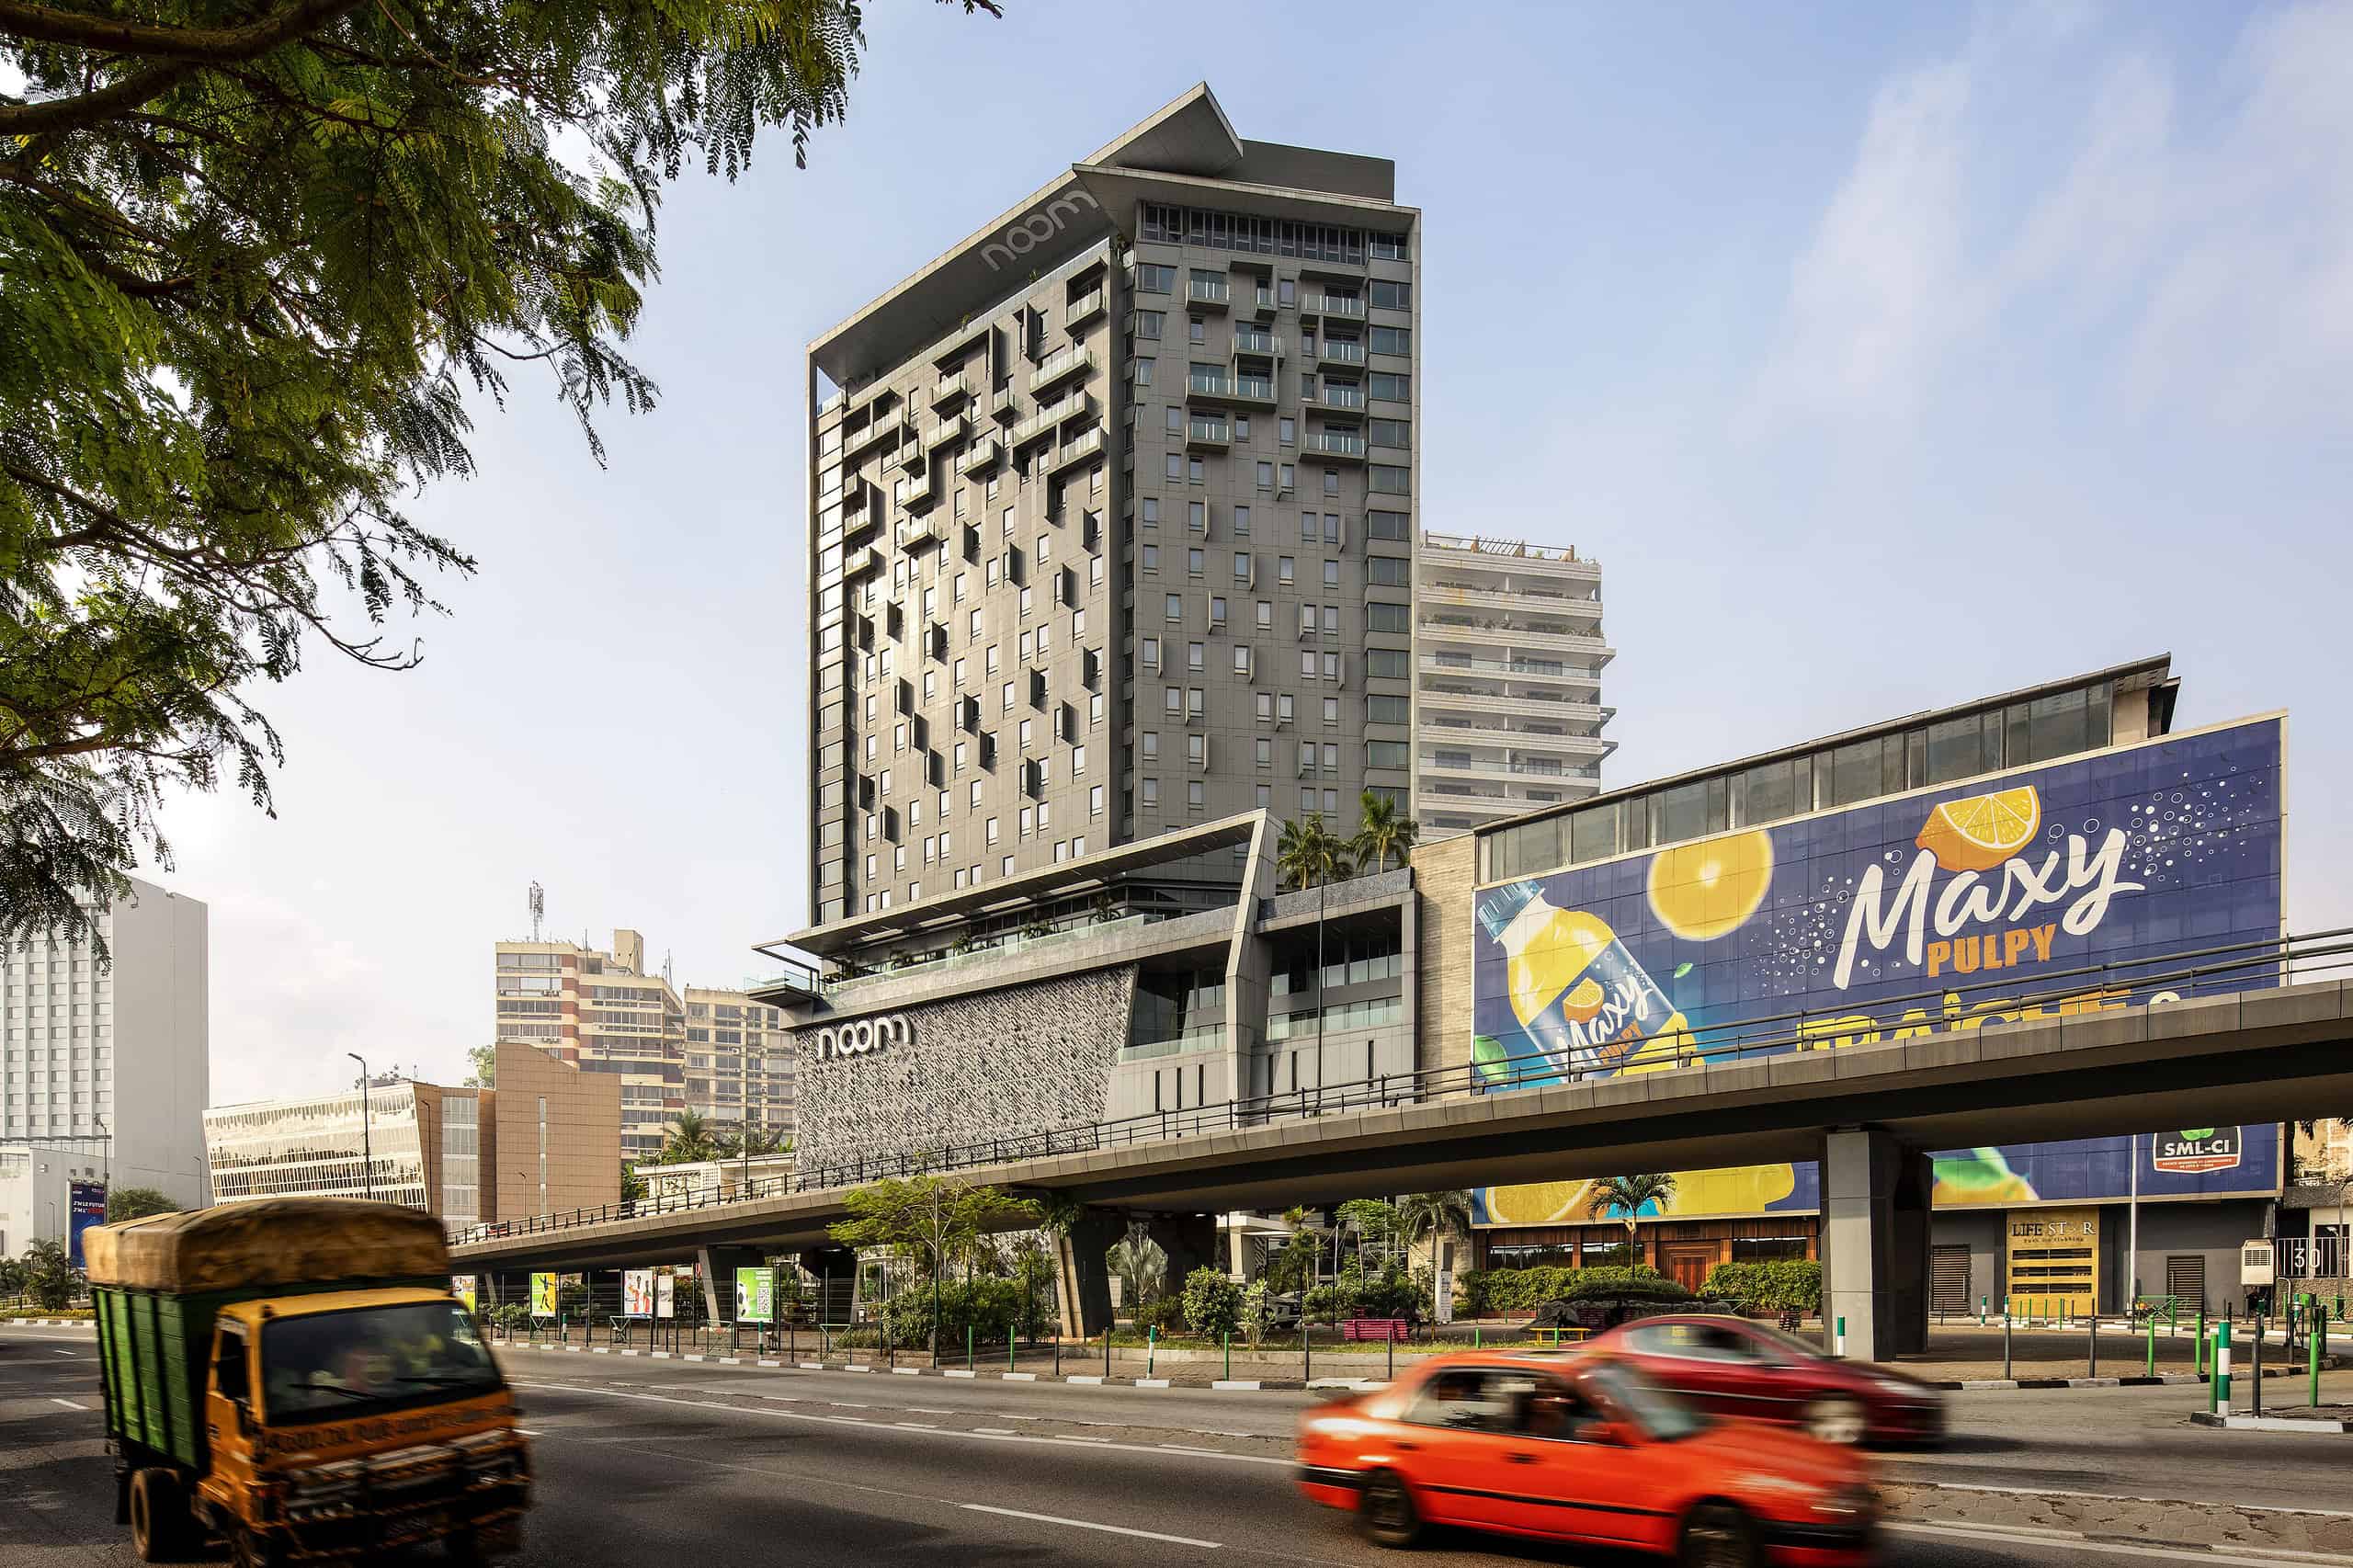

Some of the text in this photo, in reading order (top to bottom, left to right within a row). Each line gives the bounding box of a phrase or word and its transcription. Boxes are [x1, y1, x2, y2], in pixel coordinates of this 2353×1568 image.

[980, 189, 1099, 271] noom
[1833, 827, 2146, 991] Maxy
[1927, 924, 2056, 978] PULPY
[817, 1014, 912, 1058] noom
[2164, 1139, 2231, 1156] SML-CI
[2012, 1221, 2097, 1236] LIFE STR
[2294, 1247, 2321, 1268] 30
